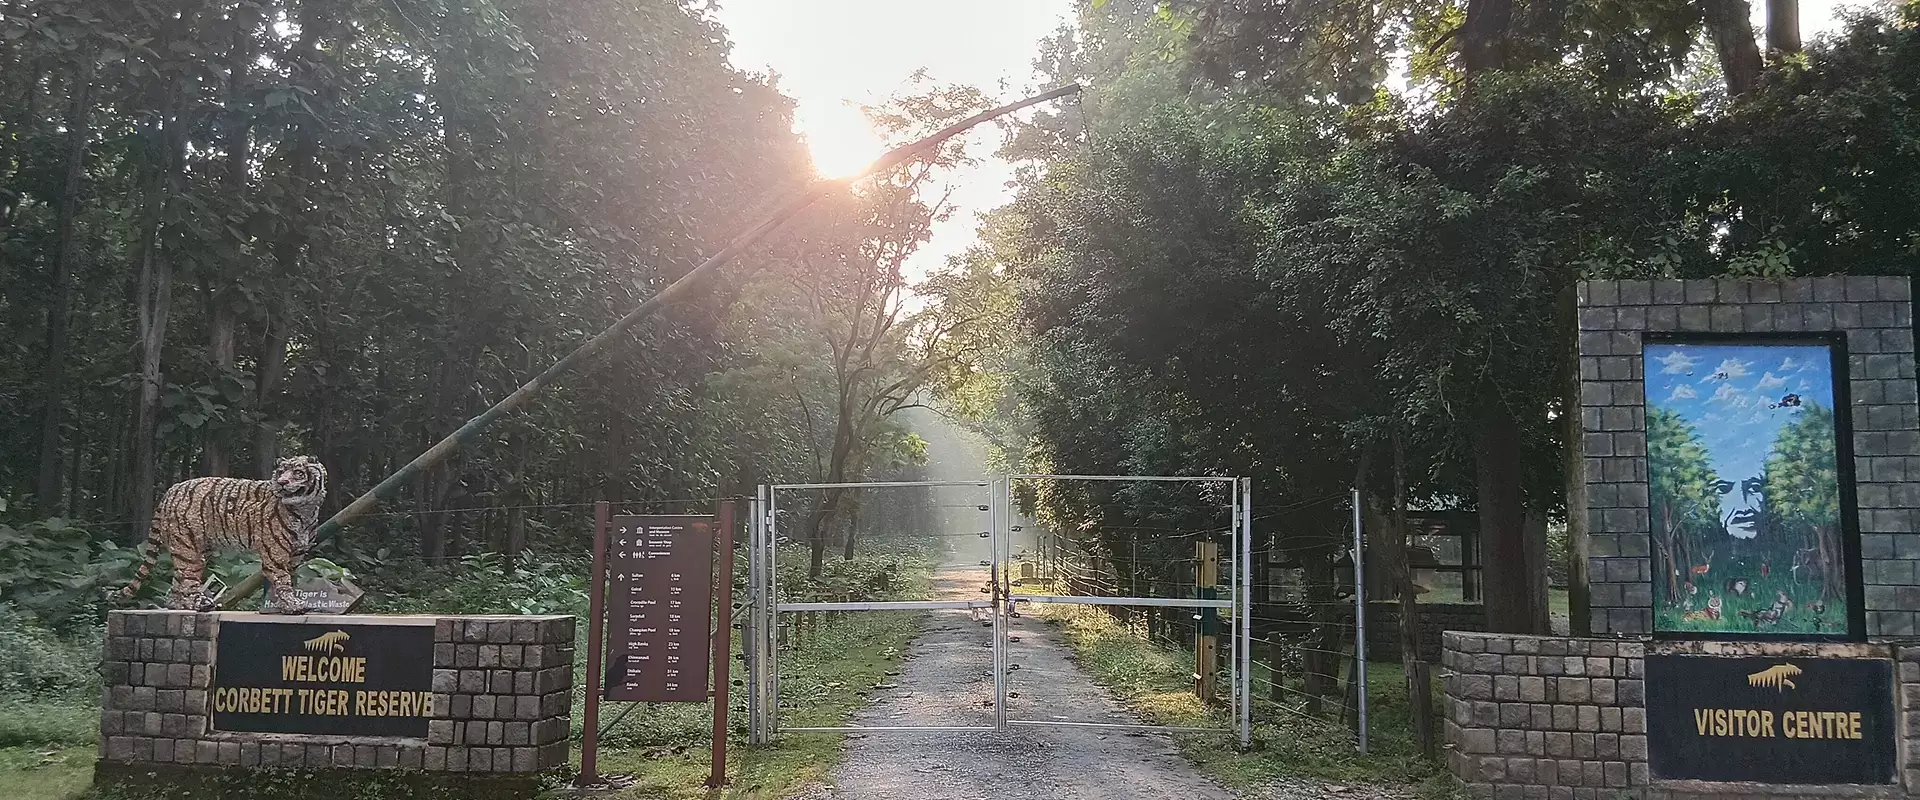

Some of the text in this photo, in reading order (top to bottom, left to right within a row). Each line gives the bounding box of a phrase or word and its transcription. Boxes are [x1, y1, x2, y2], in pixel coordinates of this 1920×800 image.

[295, 589, 328, 600] Tiger is
[328, 600, 350, 608] Waste
[282, 655, 366, 683] WELCOME
[214, 686, 434, 718] CORBETT TIGER RESERVE
[1694, 708, 1863, 740] VISITOR CENTRE
